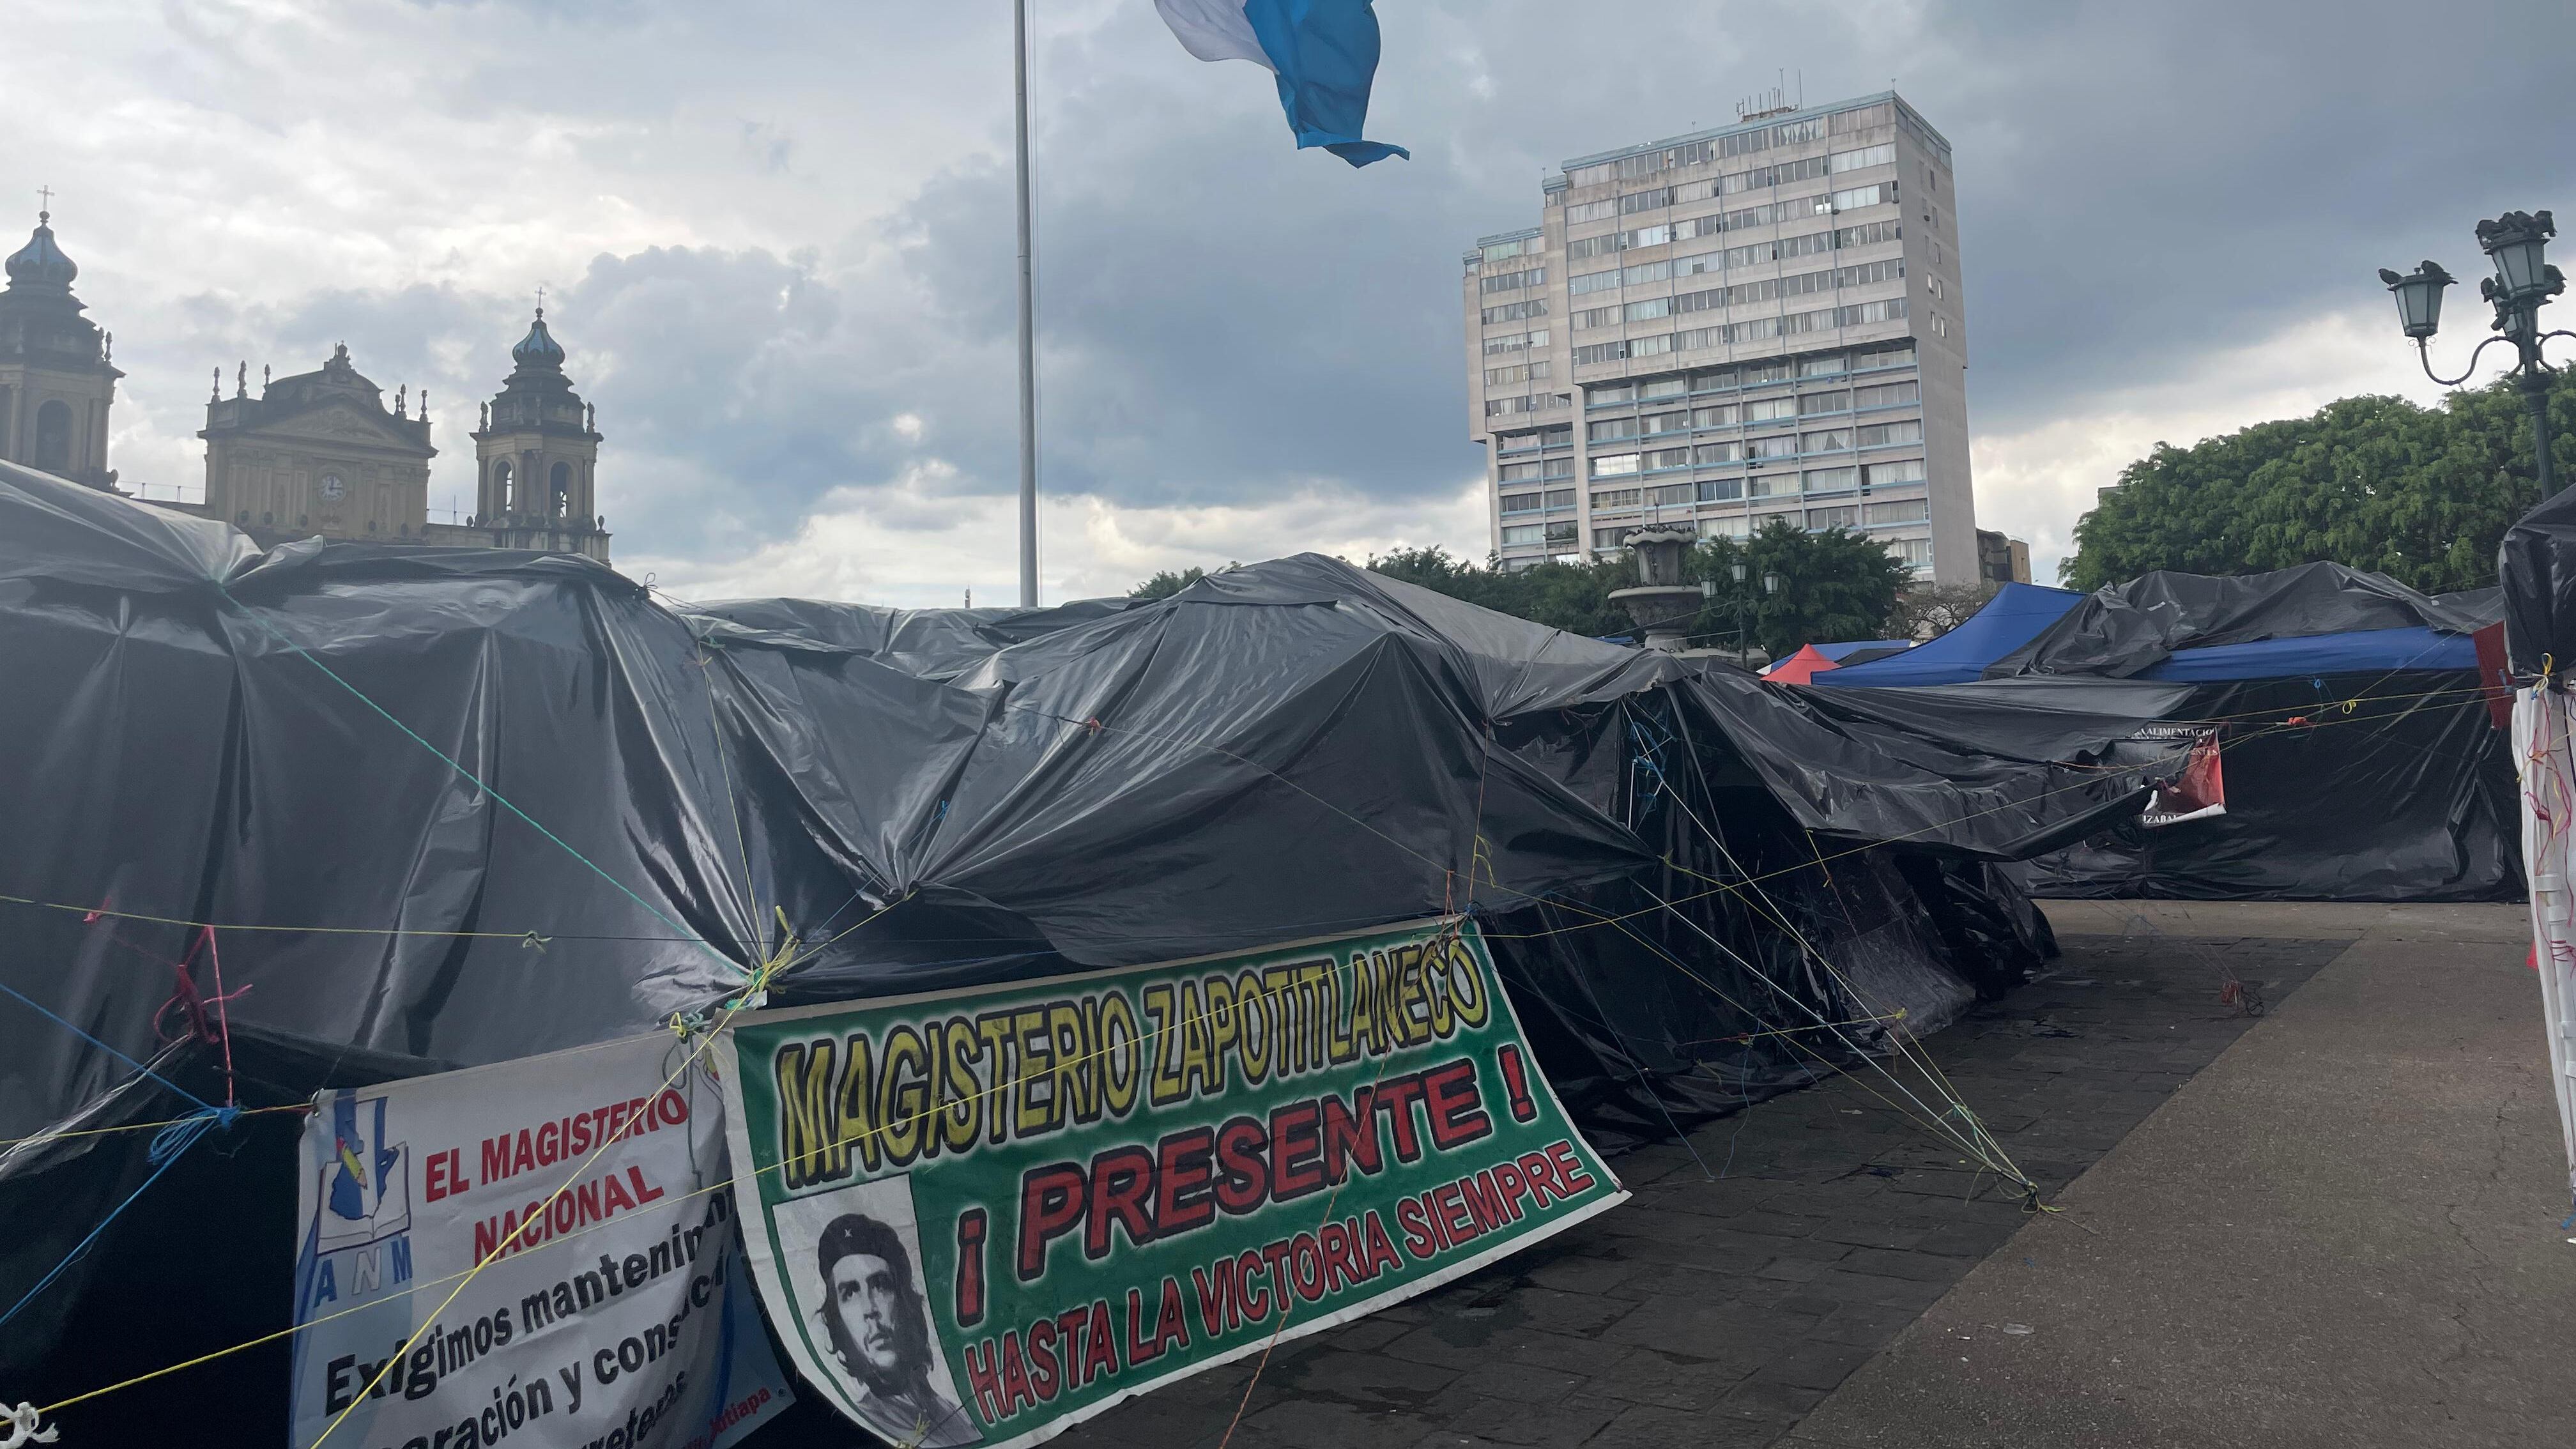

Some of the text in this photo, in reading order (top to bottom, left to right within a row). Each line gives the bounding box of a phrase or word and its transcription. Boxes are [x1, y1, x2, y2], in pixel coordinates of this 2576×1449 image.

[777, 939, 1487, 1189] MAGISTERIO ZAPOTITLANECO
[425, 1089, 688, 1202] EL MAGISTERIO
[1017, 1058, 1493, 1280] PRESENTE
[473, 1165, 664, 1268] NACIONAL
[965, 1140, 1595, 1425] HASTA LA VICTORIA SIEMPRE
[326, 1307, 513, 1416] Exigimos
[558, 1361, 581, 1414] y
